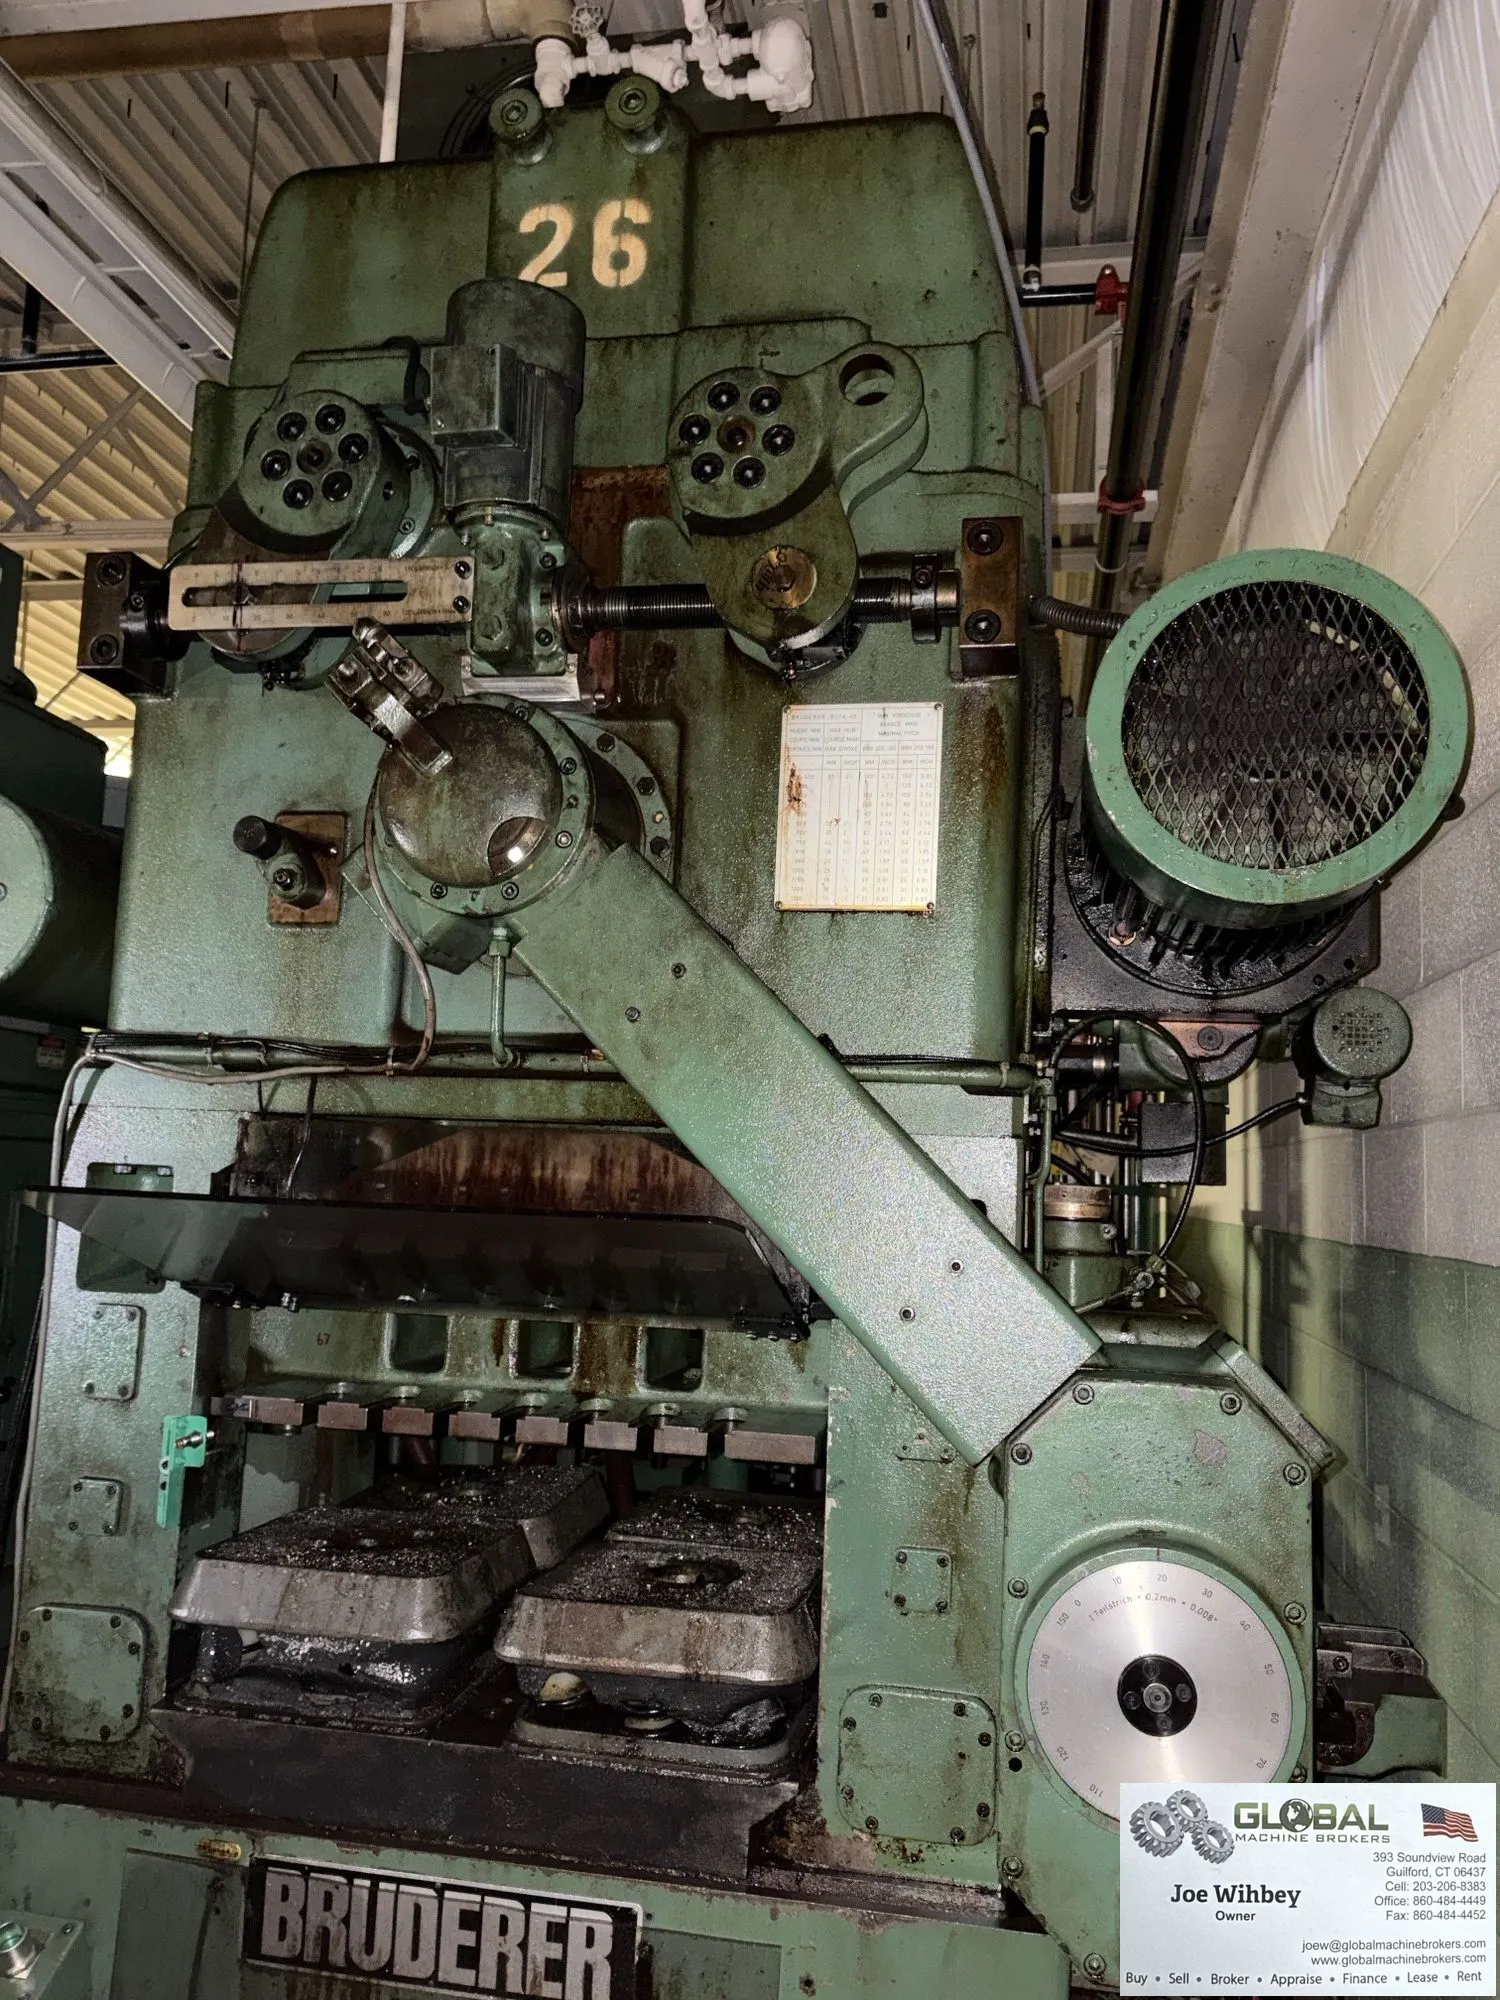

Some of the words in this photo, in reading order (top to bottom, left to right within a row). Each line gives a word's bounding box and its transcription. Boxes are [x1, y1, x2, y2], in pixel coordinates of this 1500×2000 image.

[519, 199, 652, 288] 26
[1112, 1576, 1123, 1586] 10
[1157, 1573, 1168, 1583] 20
[1201, 1587, 1213, 1599] 30
[1073, 1599, 1082, 1609] 0
[1056, 1611, 1070, 1627] 150
[1239, 1620, 1251, 1632] 40
[1040, 1653, 1051, 1669] 140
[1264, 1663, 1274, 1676] 50
[1270, 1712, 1280, 1724] 60
[1056, 1746, 1070, 1762] 120
[1256, 1757, 1267, 1769] 70
[1089, 1783, 1104, 1798] 110
[260, 1867, 614, 2000] BRUDERER
